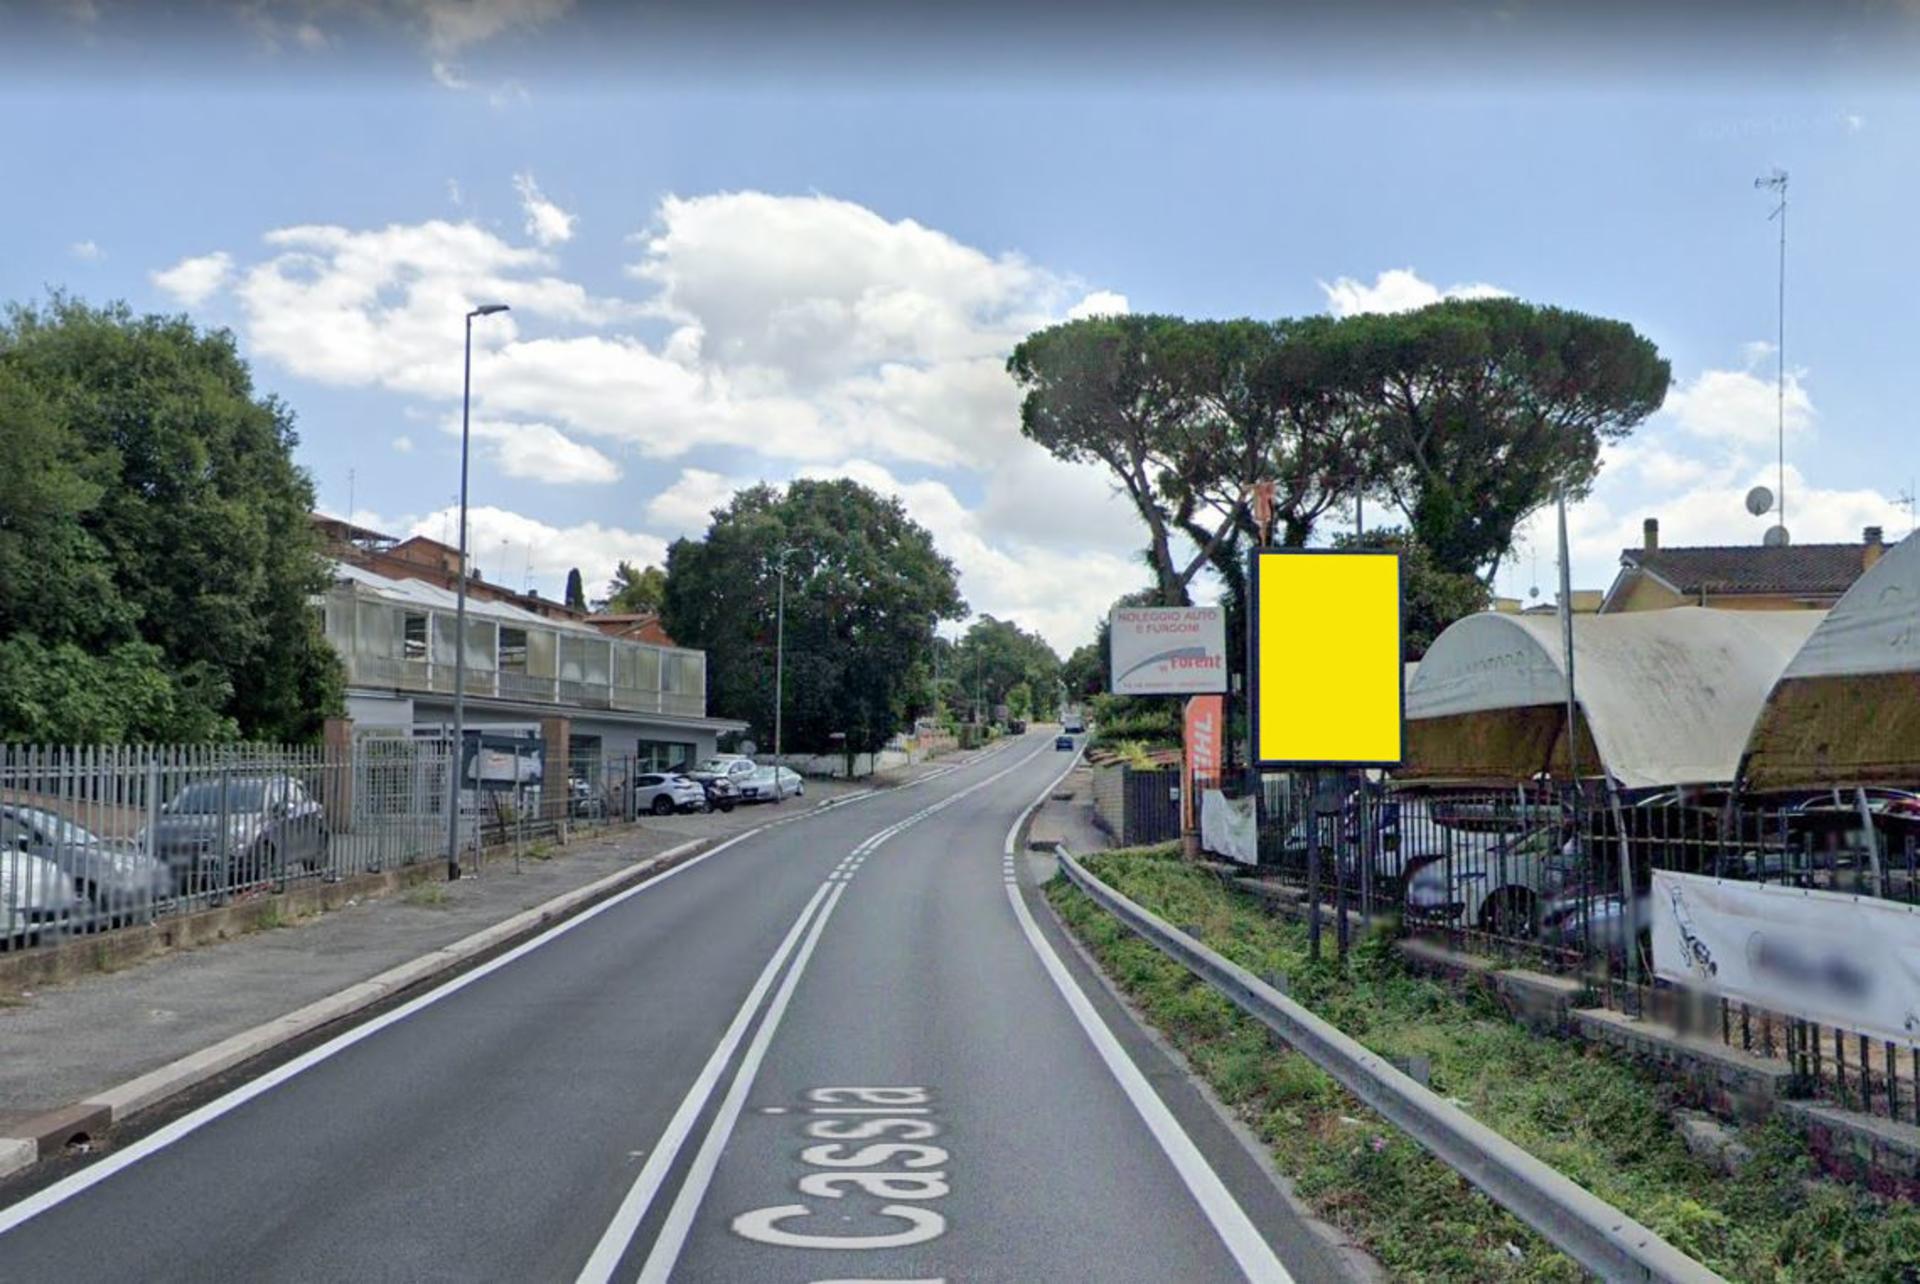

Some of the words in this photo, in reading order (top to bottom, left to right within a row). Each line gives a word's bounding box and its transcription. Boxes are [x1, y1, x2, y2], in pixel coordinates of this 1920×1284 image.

[1118, 610, 1181, 622] NOLEGGIO
[1184, 610, 1217, 621] AUTO
[1146, 623, 1200, 633] FURGONI
[731, 1086, 950, 1249] Cassia
